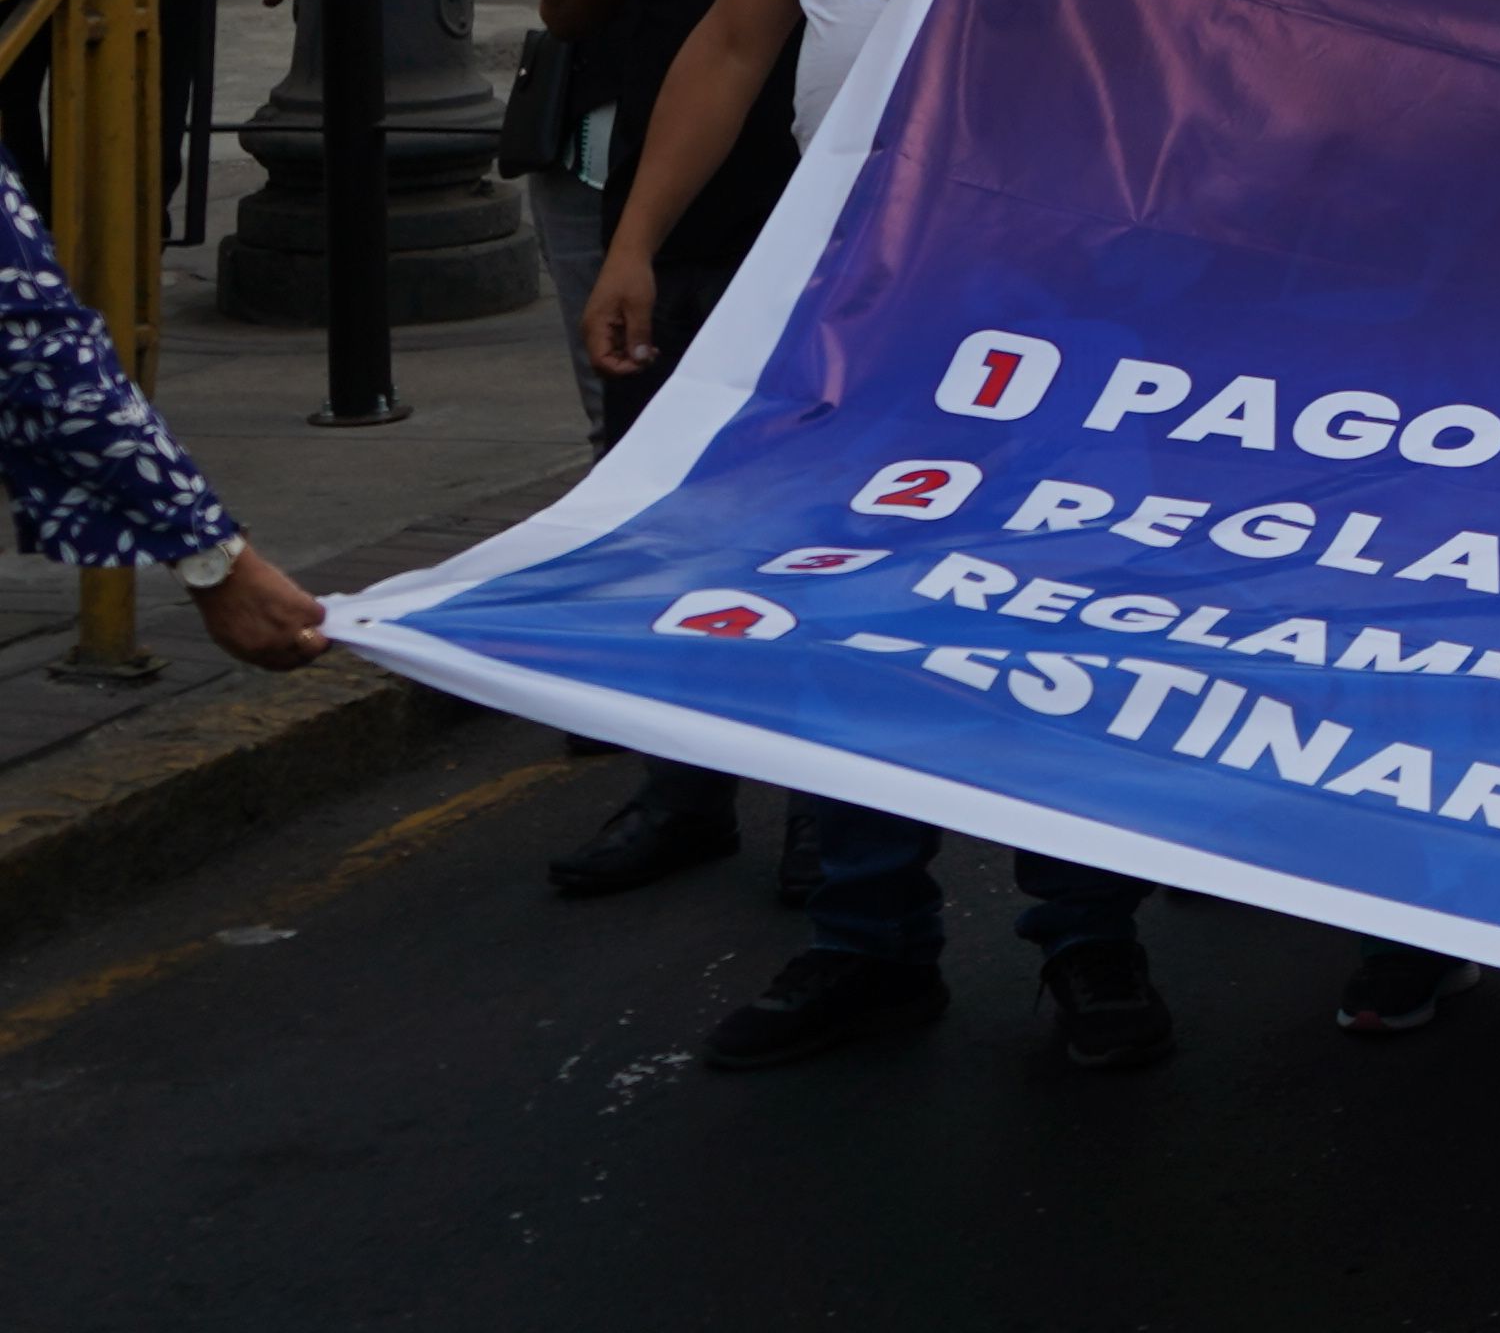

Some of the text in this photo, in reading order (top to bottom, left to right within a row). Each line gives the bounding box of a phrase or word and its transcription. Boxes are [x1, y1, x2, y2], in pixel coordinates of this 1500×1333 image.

[973, 350, 1022, 408] 1
[876, 469, 953, 510] 2
[695, 605, 764, 639] 4
